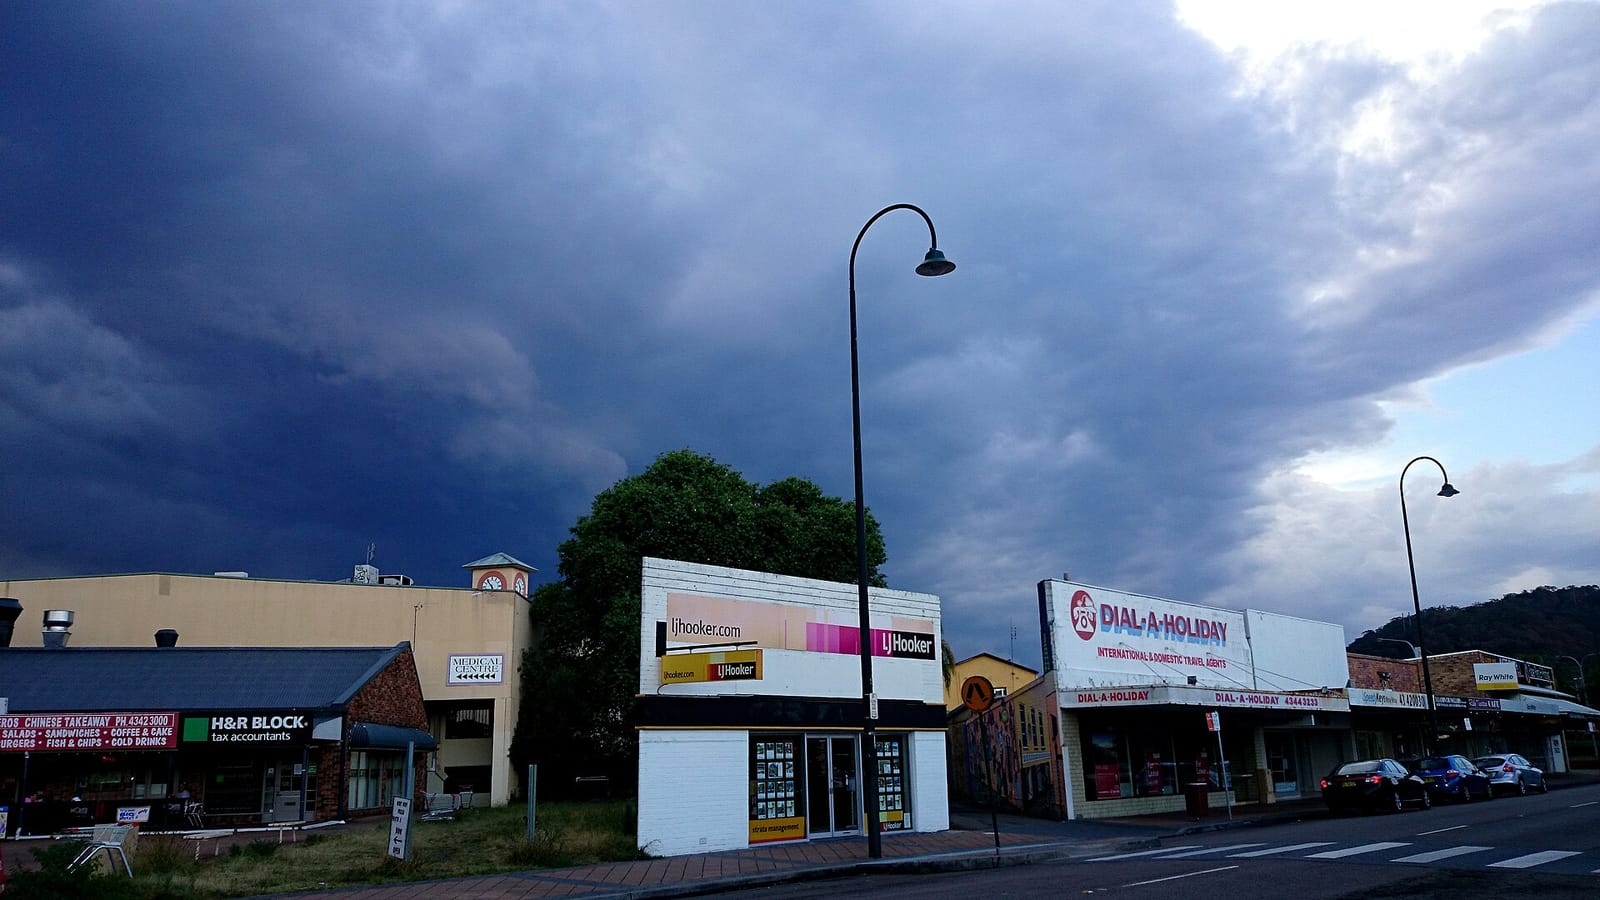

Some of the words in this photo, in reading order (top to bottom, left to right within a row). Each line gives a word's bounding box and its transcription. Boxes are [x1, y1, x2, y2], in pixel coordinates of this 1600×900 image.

[671, 617, 740, 638] ljhooker.com
[453, 658, 502, 666] MEDICAL
[1097, 646, 1148, 662] INTERNATIONAL
[1154, 653, 1183, 665] DOMESTIC
[1184, 656, 1205, 667] TRAVEL
[1206, 658, 1226, 669] AGENTS
[455, 665, 499, 673] CENTRE
[664, 671, 694, 680] ljhooker.com
[1493, 673, 1514, 681] White
[25, 717, 62, 728] CHINESE
[64, 716, 110, 727] TAKEAWAY
[211, 716, 248, 730] H&R
[252, 715, 304, 729] BLOCK
[2, 729, 36, 739] SALADS
[45, 728, 100, 739] SANDWICHES
[111, 728, 140, 737] COFFEE
[142, 728, 149, 736] &
[151, 727, 173, 736] CAKE
[211, 732, 229, 742] tax
[230, 731, 291, 741] accountants
[0, 739, 35, 748] URGERS
[47, 739, 66, 748] FISH
[68, 738, 75, 747] &
[78, 738, 102, 747] CHIPS
[111, 737, 133, 746] COLD
[135, 737, 167, 746] DRINKS
